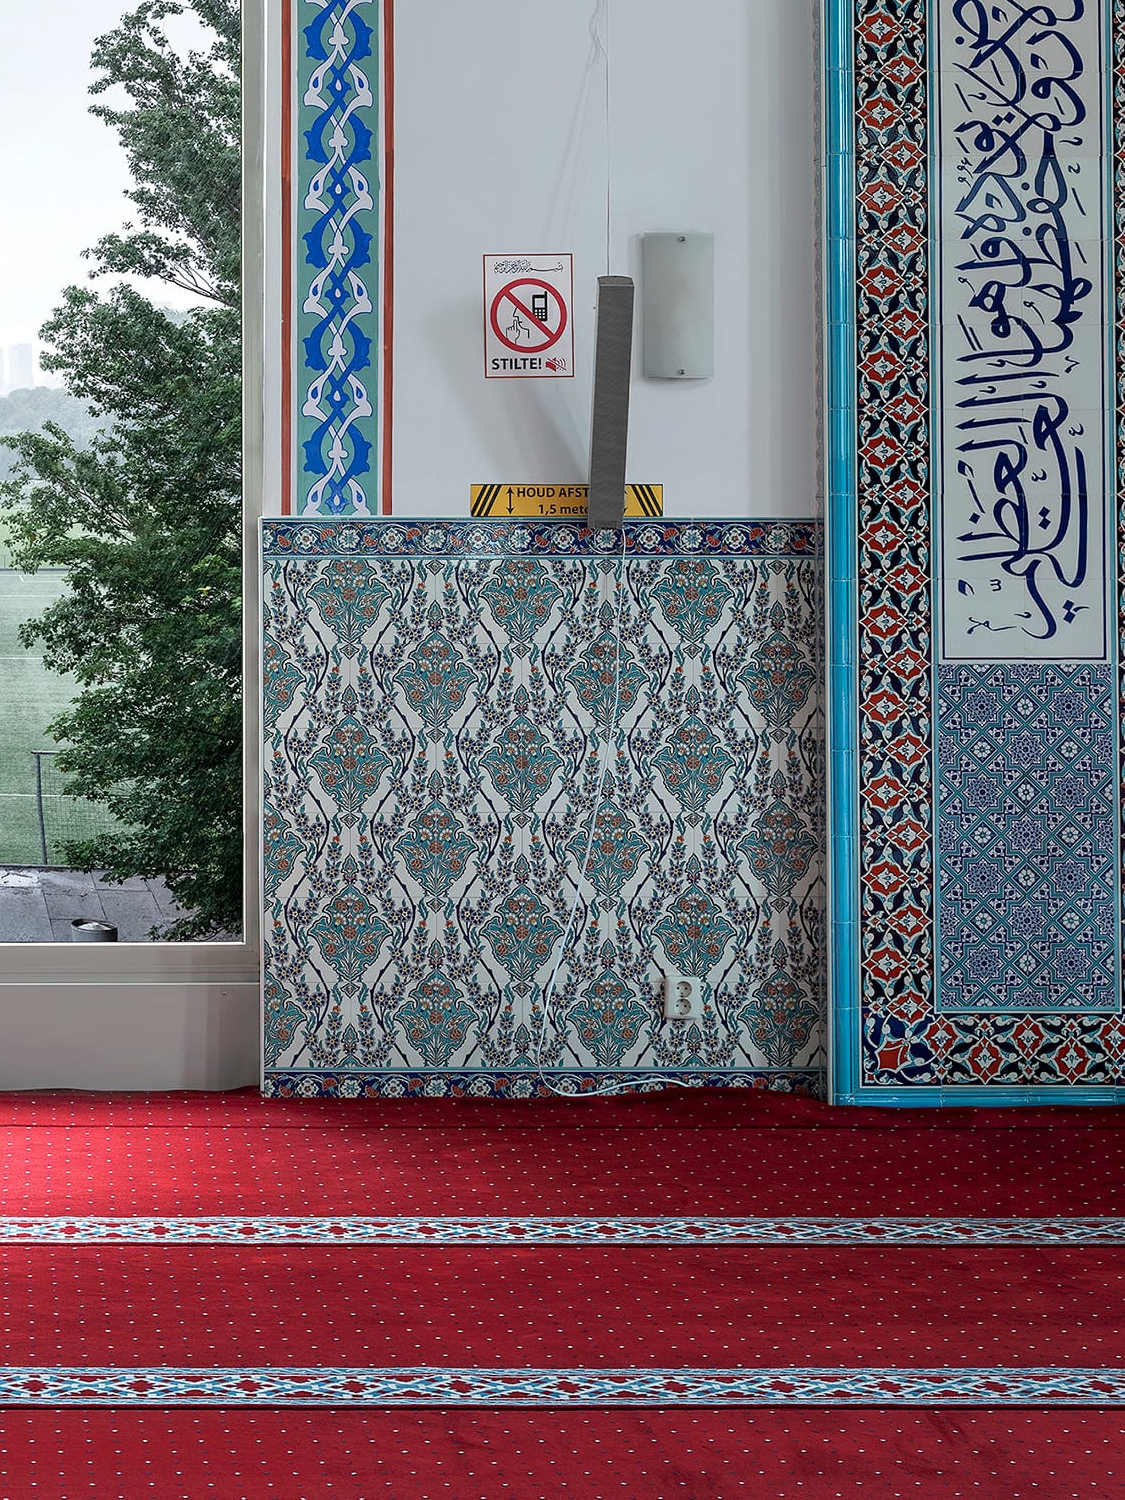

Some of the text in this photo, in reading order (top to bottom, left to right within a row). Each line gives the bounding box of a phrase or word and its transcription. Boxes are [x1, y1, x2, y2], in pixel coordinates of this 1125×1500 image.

[491, 357, 542, 371] STILTE!
[517, 487, 589, 498] HOUD AFST
[539, 504, 589, 516] 1,5 met
